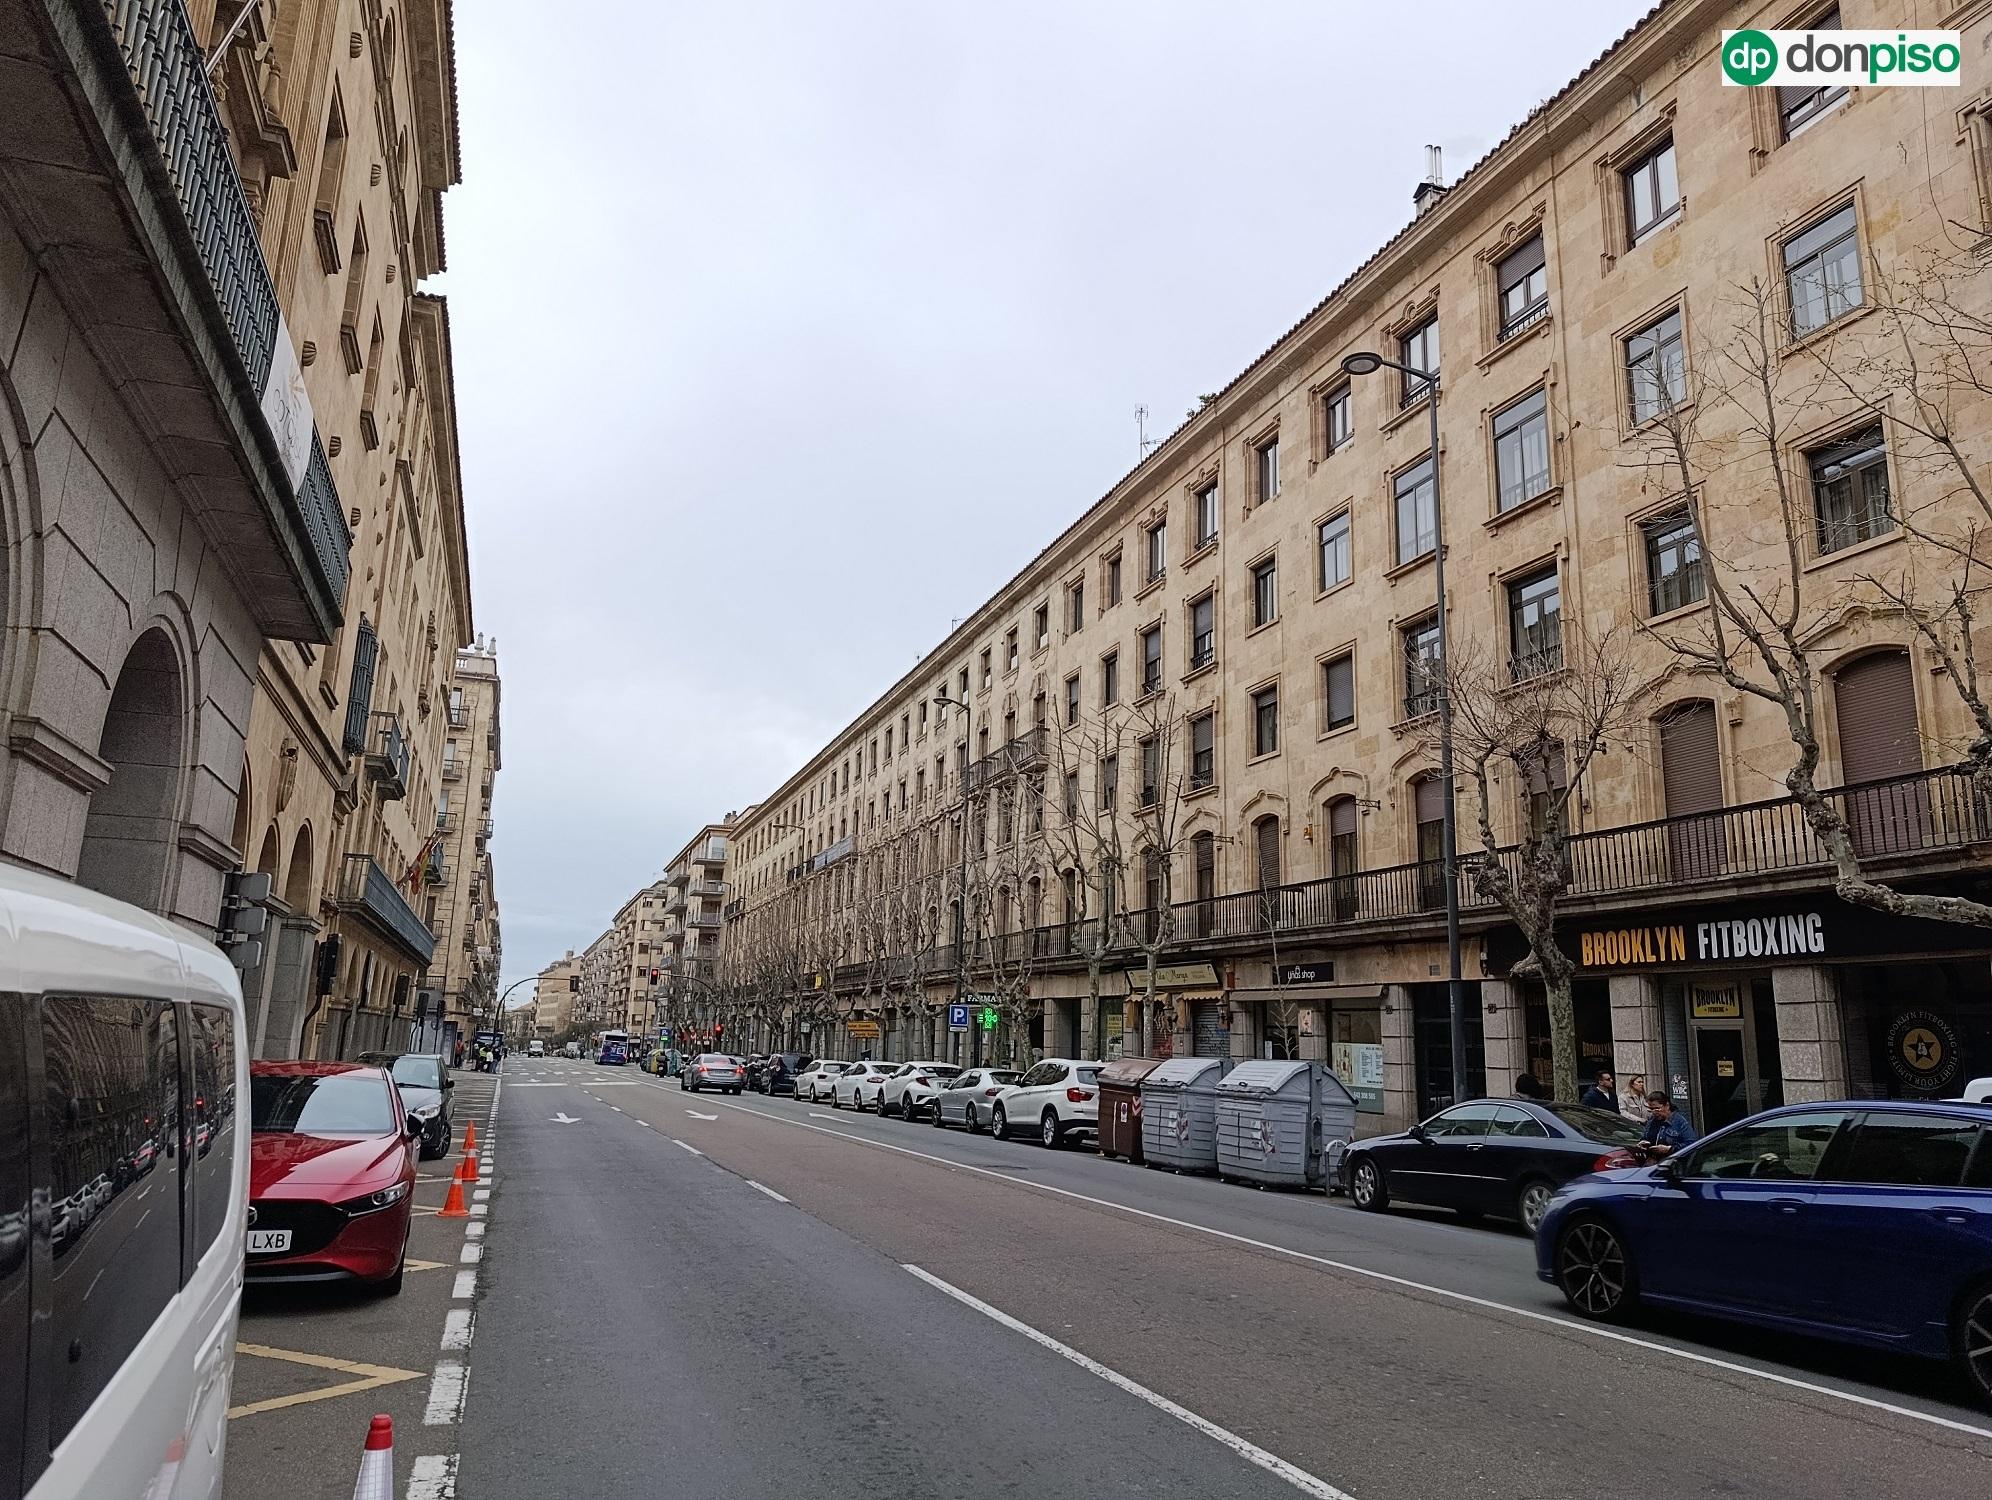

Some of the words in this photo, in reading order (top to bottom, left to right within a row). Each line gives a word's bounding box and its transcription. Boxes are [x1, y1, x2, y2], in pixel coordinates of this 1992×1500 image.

[1581, 925, 1686, 966] BROOKLYN
[1697, 912, 1825, 960] FITBOXING
[1301, 970, 1316, 981] shop
[1695, 986, 1736, 1008] BROOKLYN
[953, 1008, 964, 1022] P
[1887, 1011, 1917, 1047] BROOKLYN
[1919, 1011, 1957, 1048] FITBOXING
[1582, 1040, 1613, 1058] BROOKLYN
[1889, 1055, 1913, 1081] LIMITS
[1940, 1056, 1958, 1082] FIGHT
[1914, 1077, 1941, 1086] YOUR
[252, 1233, 286, 1249] LXB
